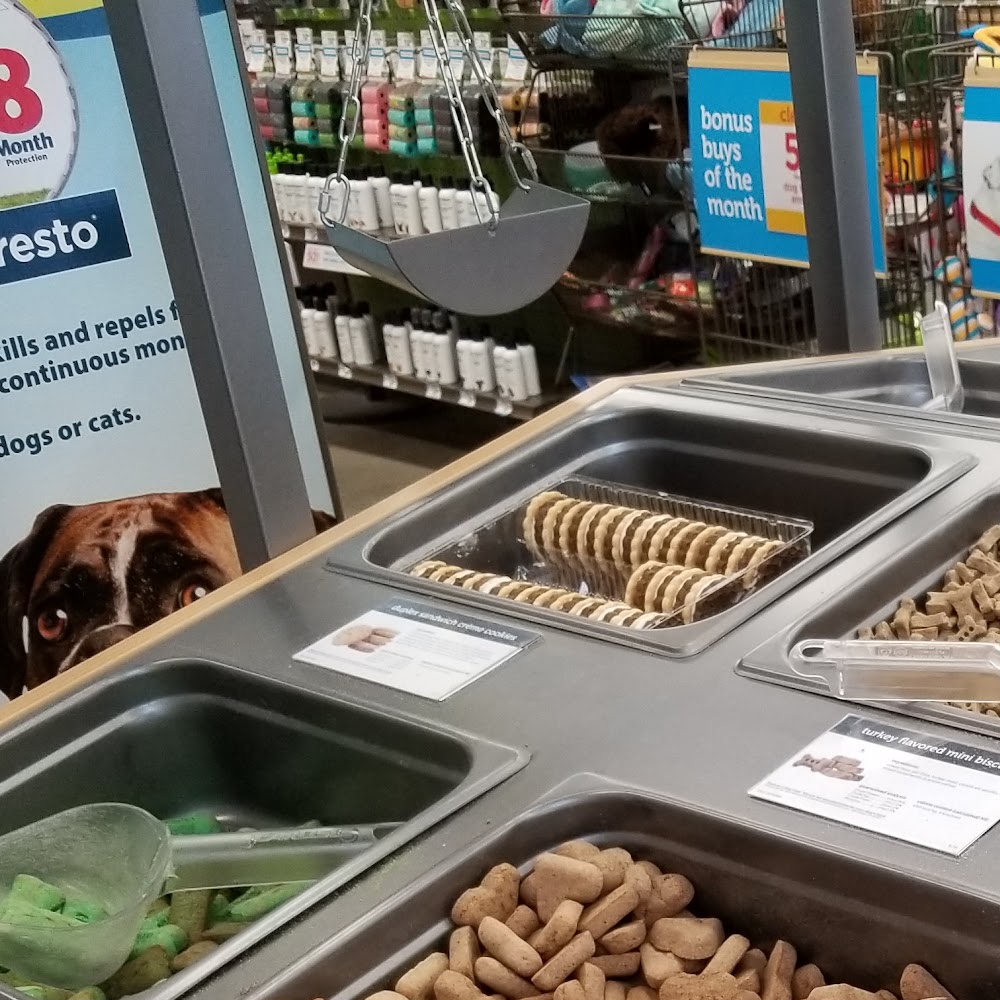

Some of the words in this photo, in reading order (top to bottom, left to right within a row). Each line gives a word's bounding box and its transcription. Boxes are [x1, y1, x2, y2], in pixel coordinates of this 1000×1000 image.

[700, 104, 753, 133] bonus
[6, 153, 48, 167] Protection
[701, 133, 742, 166] buys
[704, 165, 721, 188] of
[725, 165, 753, 191] the
[707, 197, 763, 221] month
[44, 320, 91, 351] and
[94, 305, 166, 339] repels
[0, 347, 130, 394] continuous
[58, 420, 82, 440] or
[88, 407, 141, 433] cats.
[861, 727, 899, 743] turkey
[898, 737, 947, 754] flavored
[945, 750, 976, 761] mini
